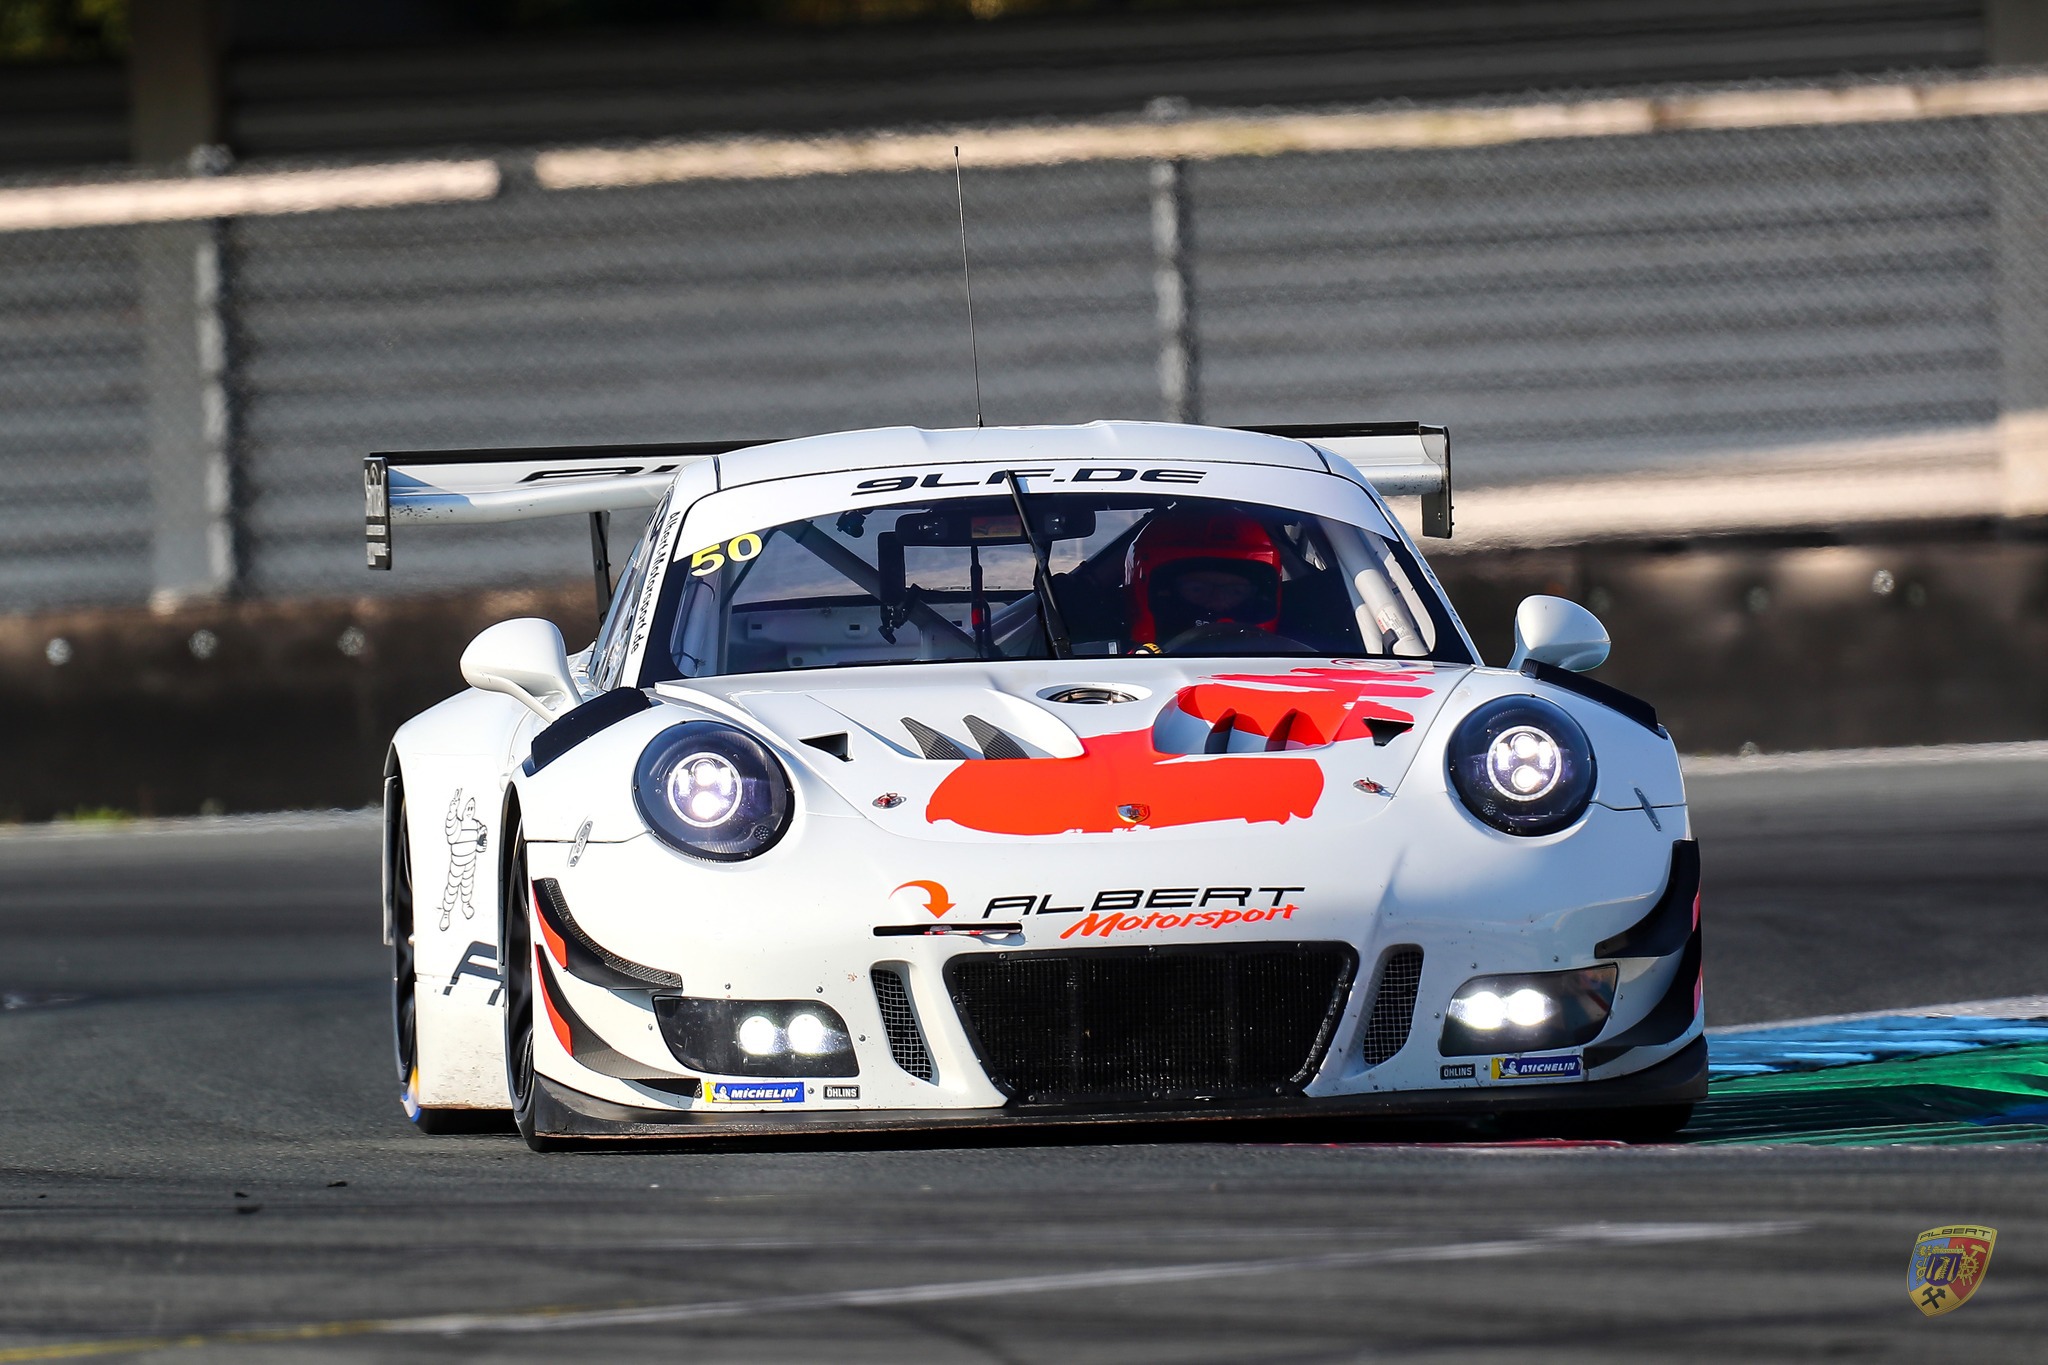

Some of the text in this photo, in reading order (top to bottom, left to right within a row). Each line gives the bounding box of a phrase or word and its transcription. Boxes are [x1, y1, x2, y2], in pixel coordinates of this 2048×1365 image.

[690, 532, 763, 577] 50
[982, 887, 1305, 919] ALBERT
[1059, 904, 1299, 939] Motorsport
[1520, 1062, 1576, 1073] MICHELIN
[730, 1087, 799, 1099] MICHELIN
[826, 1084, 858, 1098] ÖHLINS
